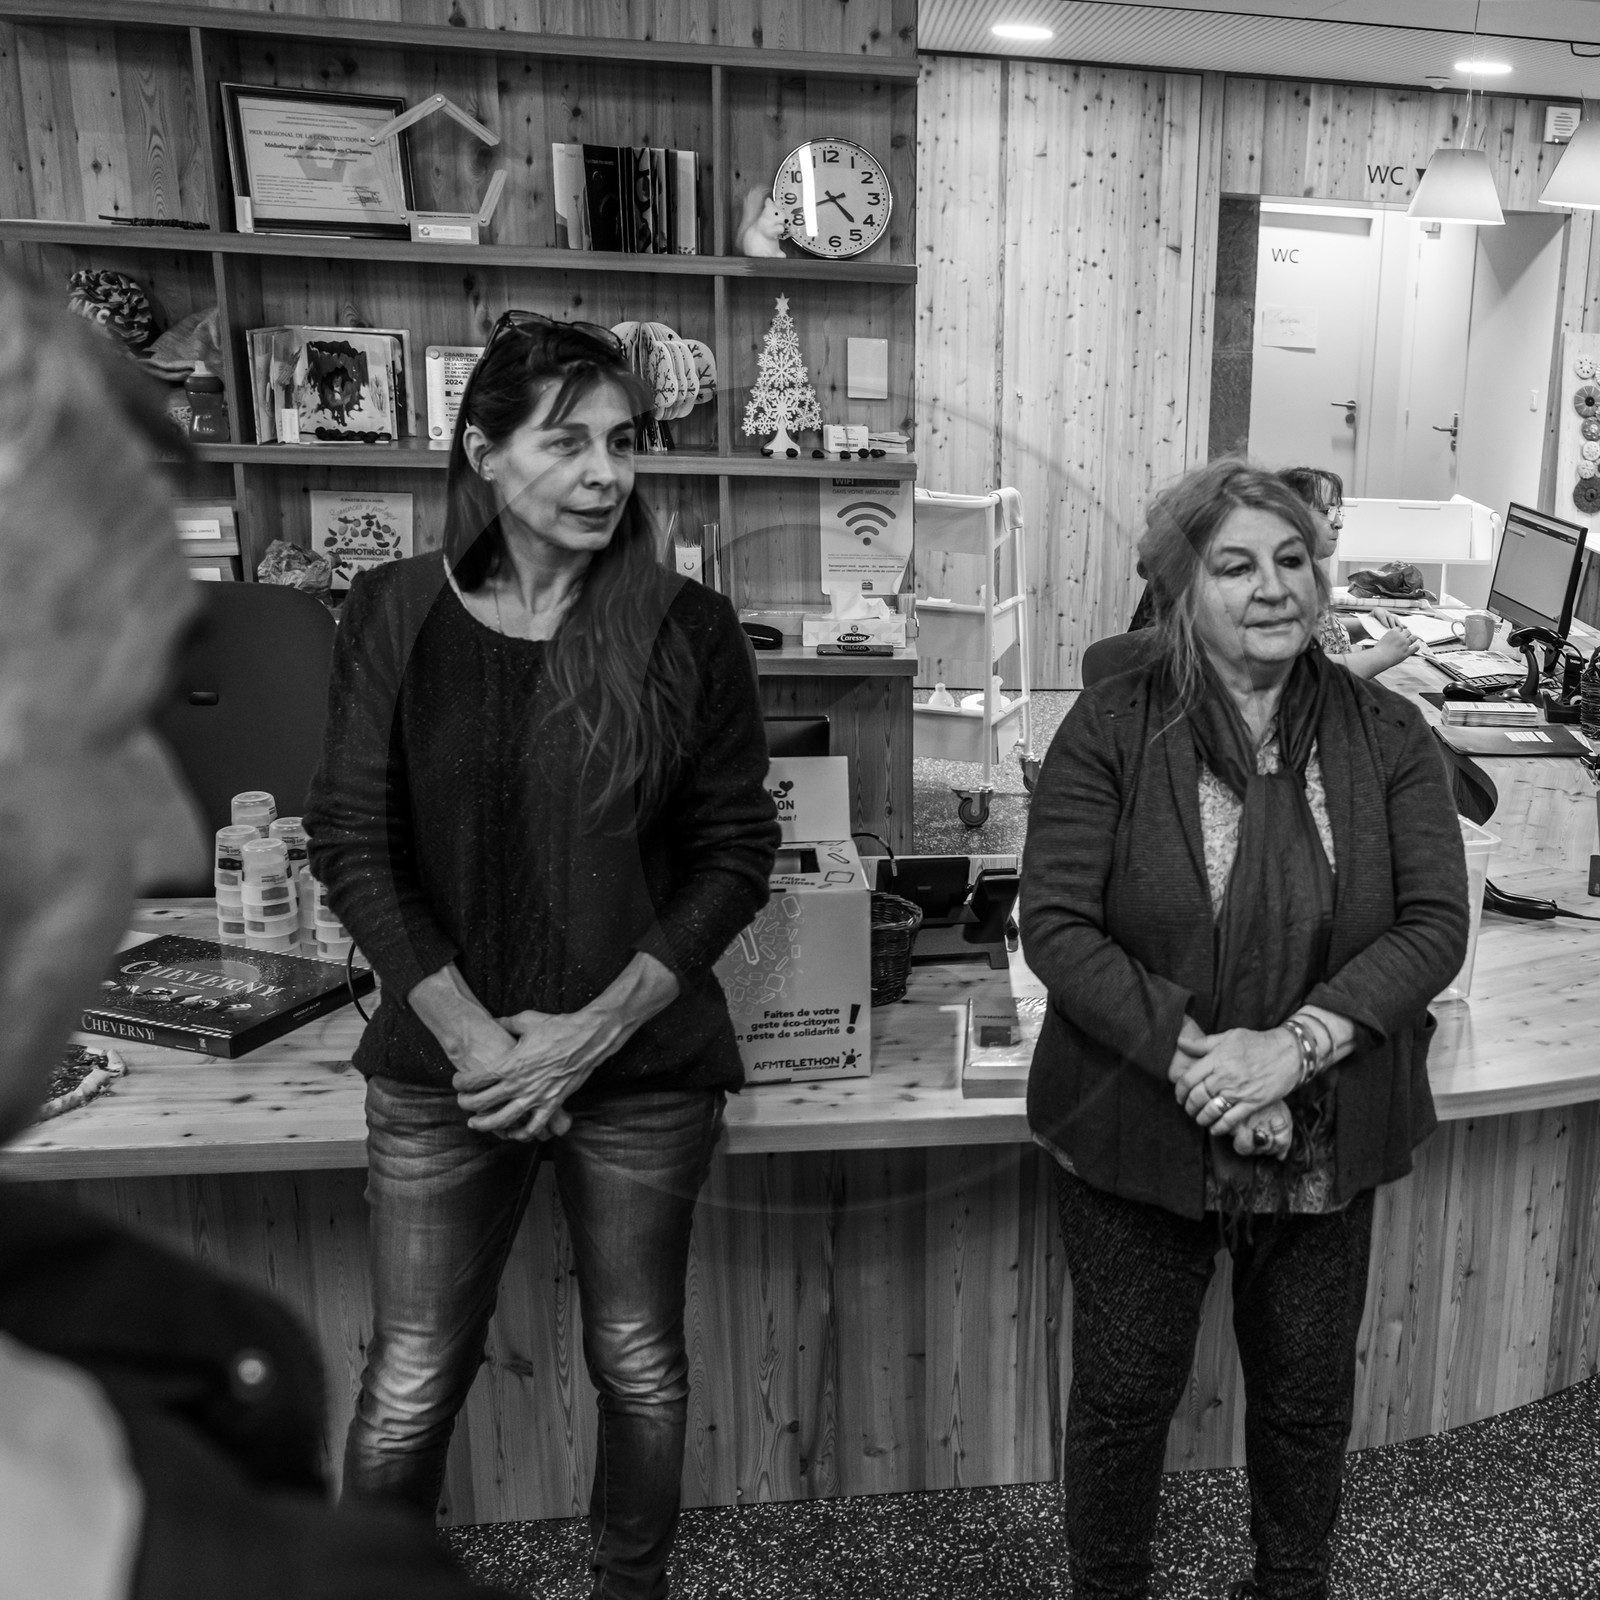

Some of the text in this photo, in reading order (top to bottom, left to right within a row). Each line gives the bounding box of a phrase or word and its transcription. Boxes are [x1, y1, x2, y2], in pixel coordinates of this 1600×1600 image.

[822, 150, 840, 163] 12
[850, 156, 855, 169] 1
[791, 170, 803, 184] 10
[861, 171, 874, 184] 2
[1367, 164, 1404, 186] WC
[784, 192, 798, 205] 9
[867, 192, 881, 206] 3
[792, 213, 805, 227] 8
[862, 214, 876, 227] 4
[828, 235, 842, 248] 6
[849, 229, 863, 242] 5
[1271, 248, 1300, 264] WC
[840, 633, 867, 642] Caresse
[120, 960, 285, 998] CHEVERNY
[764, 1008, 840, 1019] Faites de votre
[81, 1012, 156, 1041] CHEVERNY
[751, 1017, 840, 1032] geste éco-citoyen
[746, 1032, 775, 1042] geste
[777, 1030, 790, 1038] de
[793, 1027, 840, 1037] solidarité
